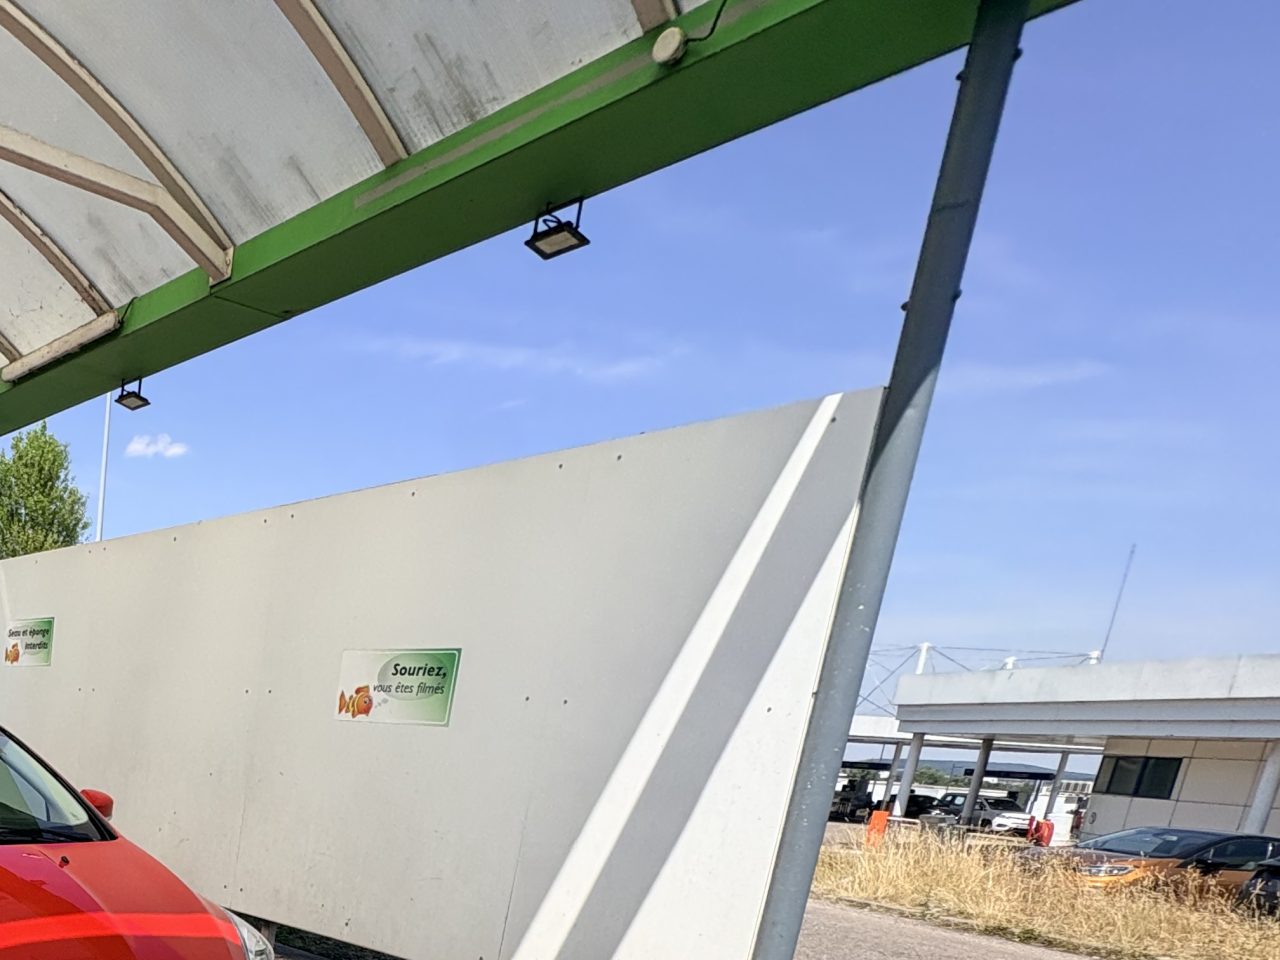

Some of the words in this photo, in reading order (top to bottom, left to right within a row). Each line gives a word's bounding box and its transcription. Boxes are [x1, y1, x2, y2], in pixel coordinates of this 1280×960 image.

[391, 663, 447, 679] Souriez,
[373, 683, 392, 693] vous
[395, 682, 414, 694] êtes
[416, 682, 445, 697] filmés
